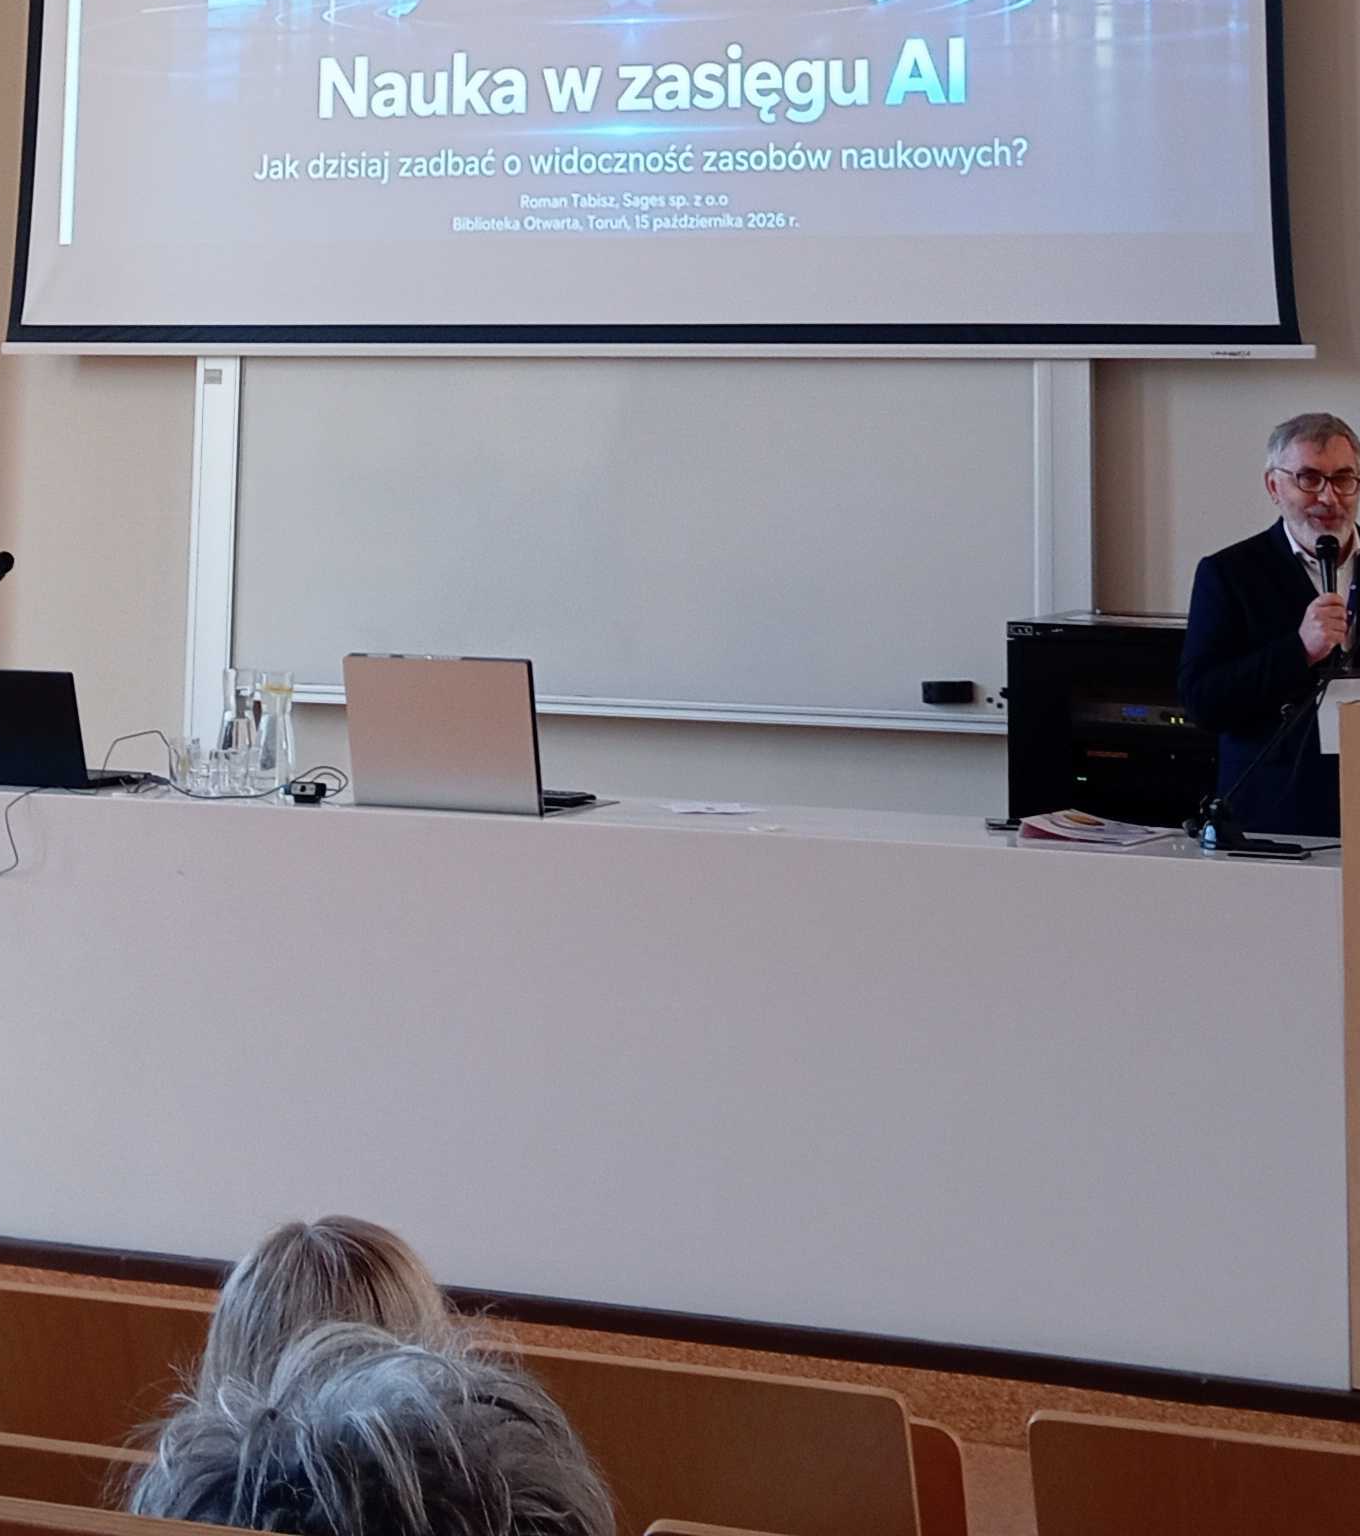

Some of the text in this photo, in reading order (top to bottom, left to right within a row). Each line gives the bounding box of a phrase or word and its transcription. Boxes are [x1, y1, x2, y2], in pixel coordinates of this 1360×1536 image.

[317, 35, 967, 124] Nauka w zasięgu AI
[253, 137, 1029, 184] Jak dzisiaj zadbać o widoczność zasobów naukowych?
[520, 193, 567, 209] Roman
[571, 193, 620, 210] Tabisz,
[622, 192, 666, 212] Sages
[668, 194, 690, 211] sp.
[693, 194, 703, 207] z
[452, 212, 801, 233] Biblioteka Otwarta, Toruń, 15 października 2026 r.
